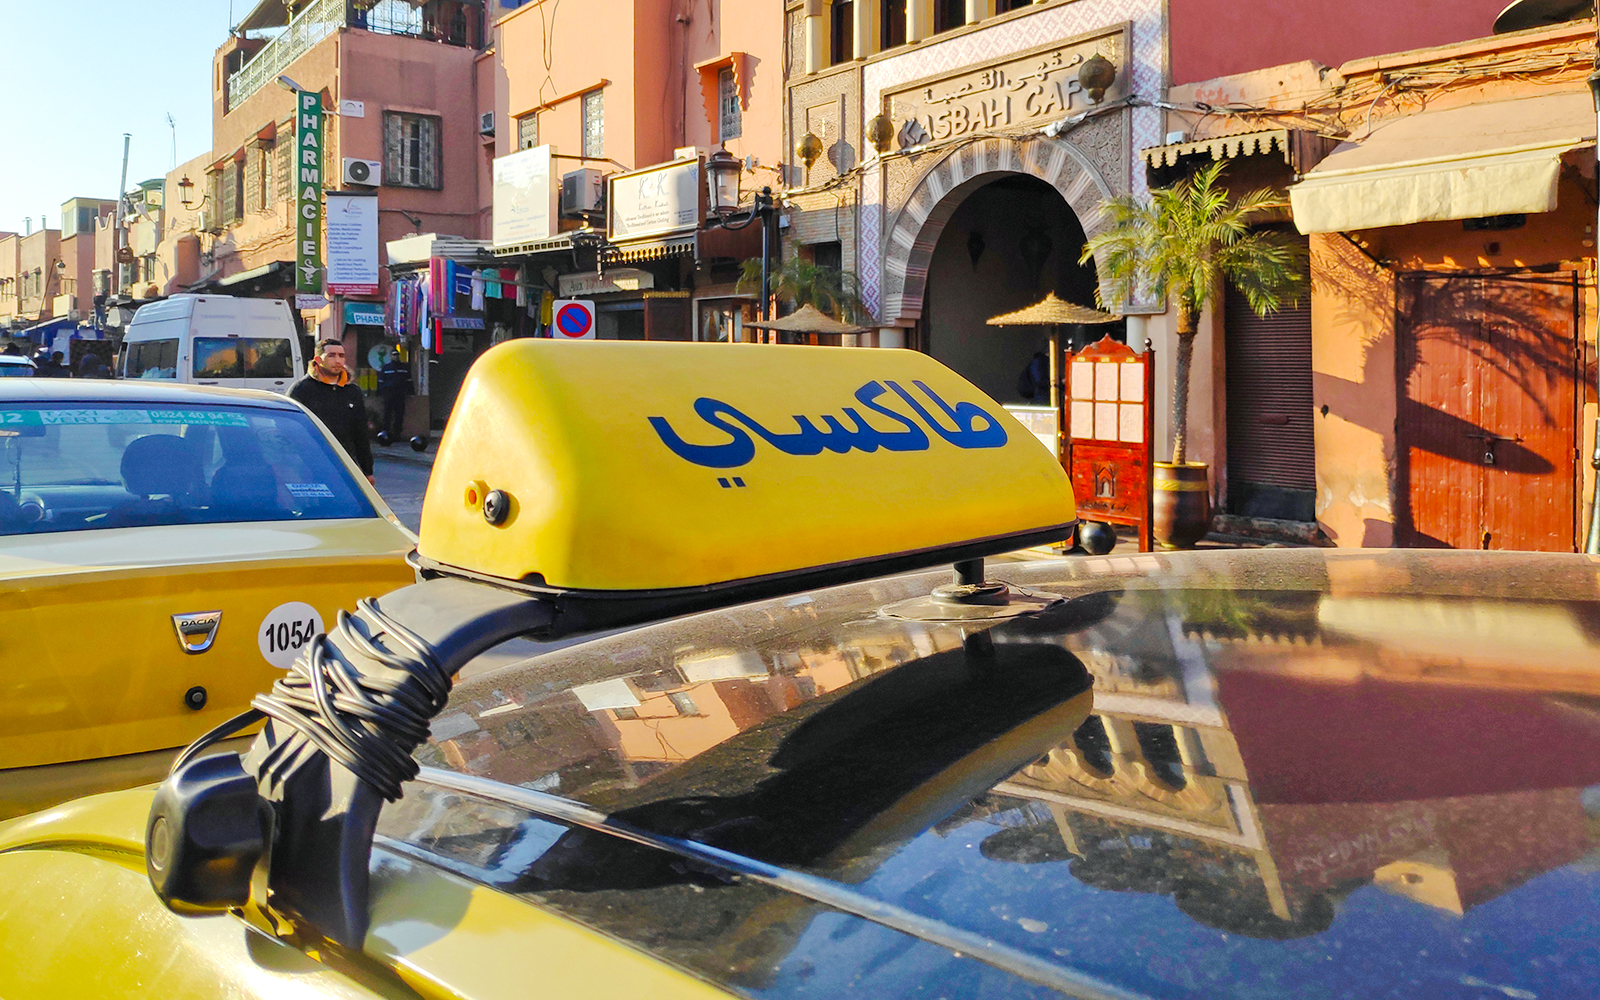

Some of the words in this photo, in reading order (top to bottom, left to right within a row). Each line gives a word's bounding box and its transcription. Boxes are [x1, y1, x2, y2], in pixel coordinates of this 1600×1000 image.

[923, 69, 1005, 105] القصبة
[1007, 52, 1084, 92] مقهى
[902, 95, 1012, 146] KASBAH
[301, 95, 318, 255] PHARMACIE
[0, 413, 24, 423] 2
[647, 380, 1008, 489] طاكسي
[180, 618, 216, 627] DACIA
[265, 618, 315, 653] 1054
